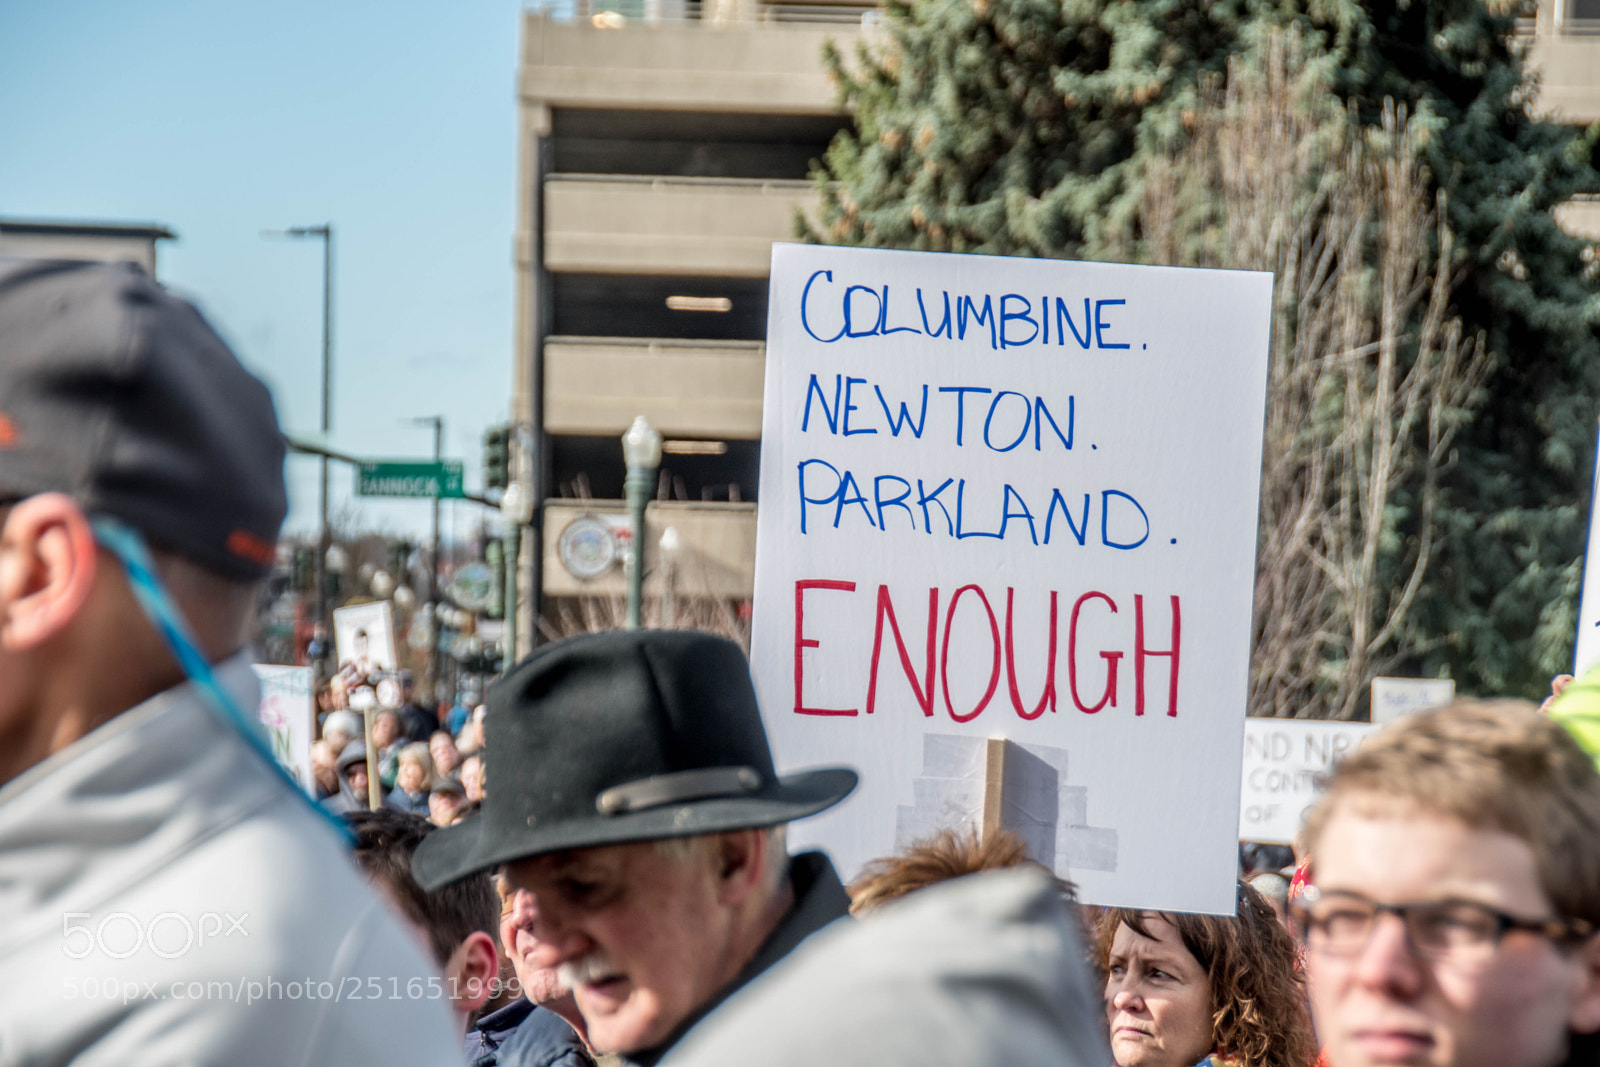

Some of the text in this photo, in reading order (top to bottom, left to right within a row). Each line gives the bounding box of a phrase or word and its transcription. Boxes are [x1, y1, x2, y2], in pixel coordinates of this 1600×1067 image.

[801, 270, 1148, 351] COLUMBINE.
[801, 373, 1098, 453] NEWTON.
[797, 458, 1178, 551] PARKLAND.
[793, 578, 1182, 724] ENOUGH
[1245, 731, 1367, 764] ND NR
[1248, 766, 1330, 794] CONTR
[1244, 803, 1281, 824] OF
